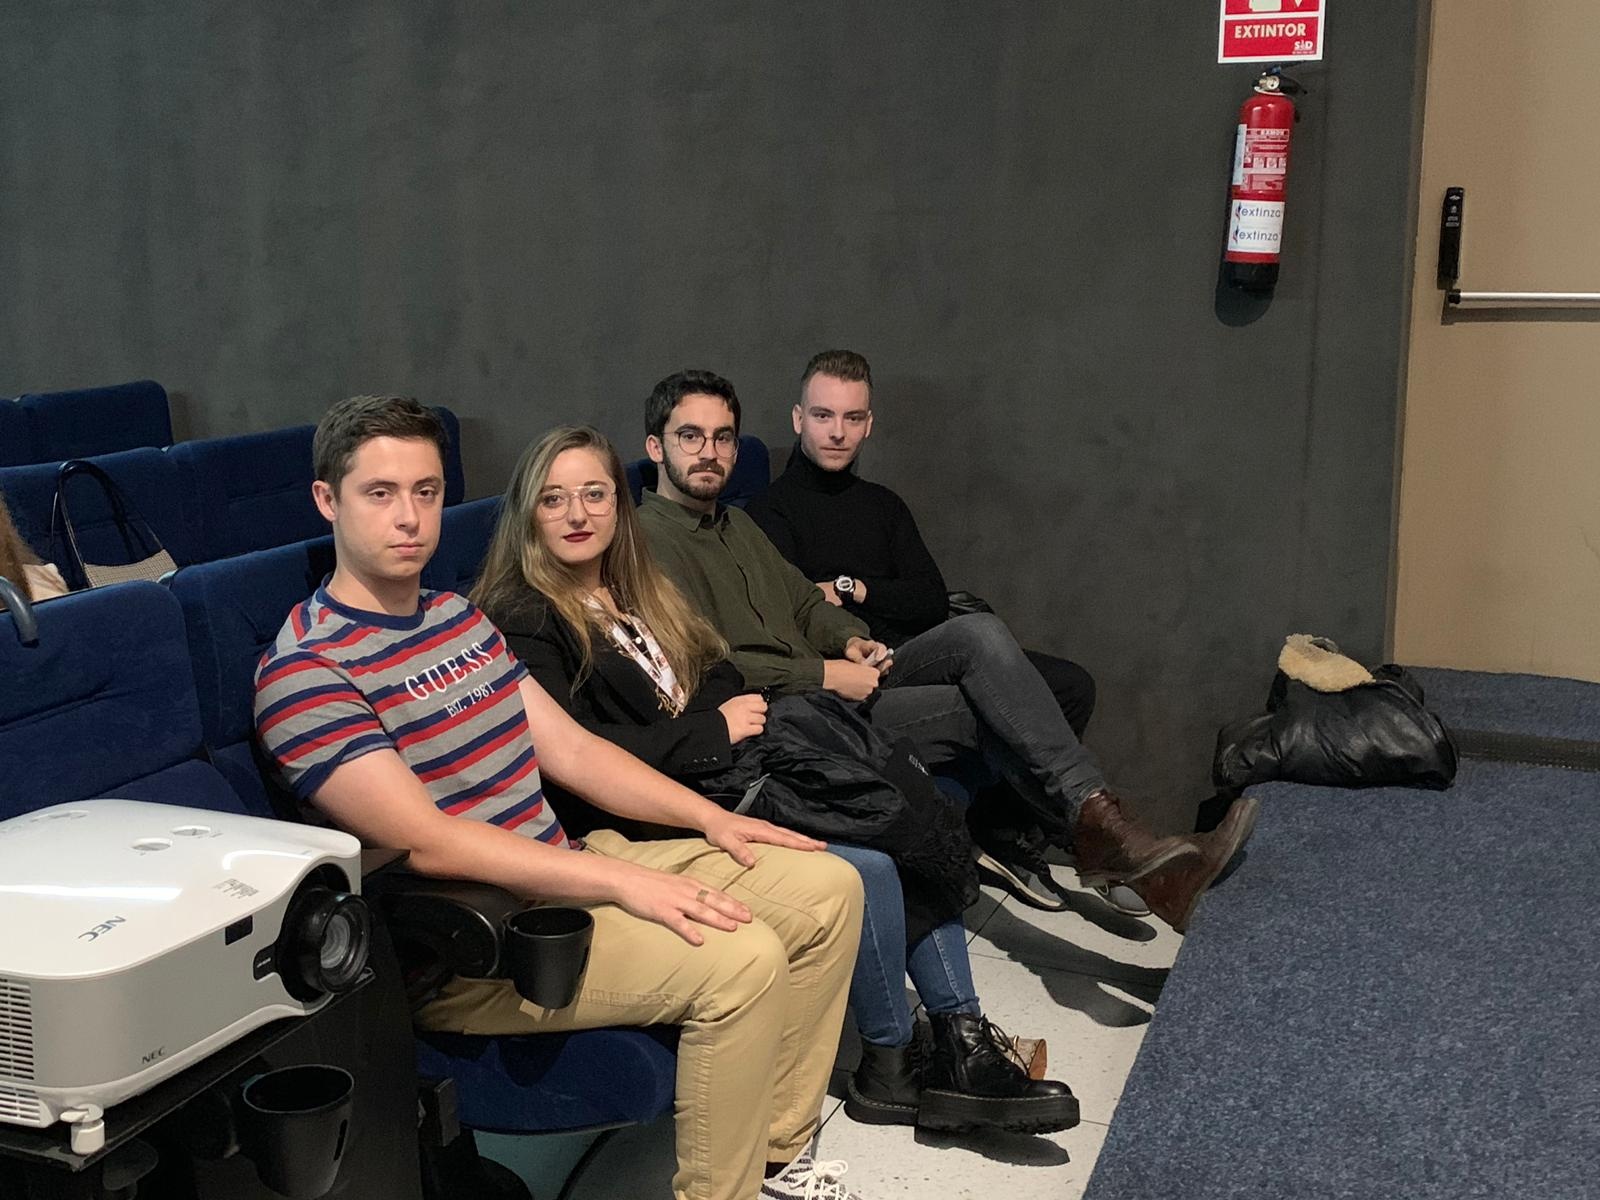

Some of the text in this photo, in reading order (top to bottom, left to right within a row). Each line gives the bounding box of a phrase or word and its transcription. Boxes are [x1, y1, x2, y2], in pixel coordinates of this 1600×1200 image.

[1235, 23, 1306, 38] EXTINTOR
[404, 642, 493, 700] GUESS
[467, 681, 495, 705] 1981
[78, 915, 127, 942] NEC
[142, 1046, 165, 1064] NEC
